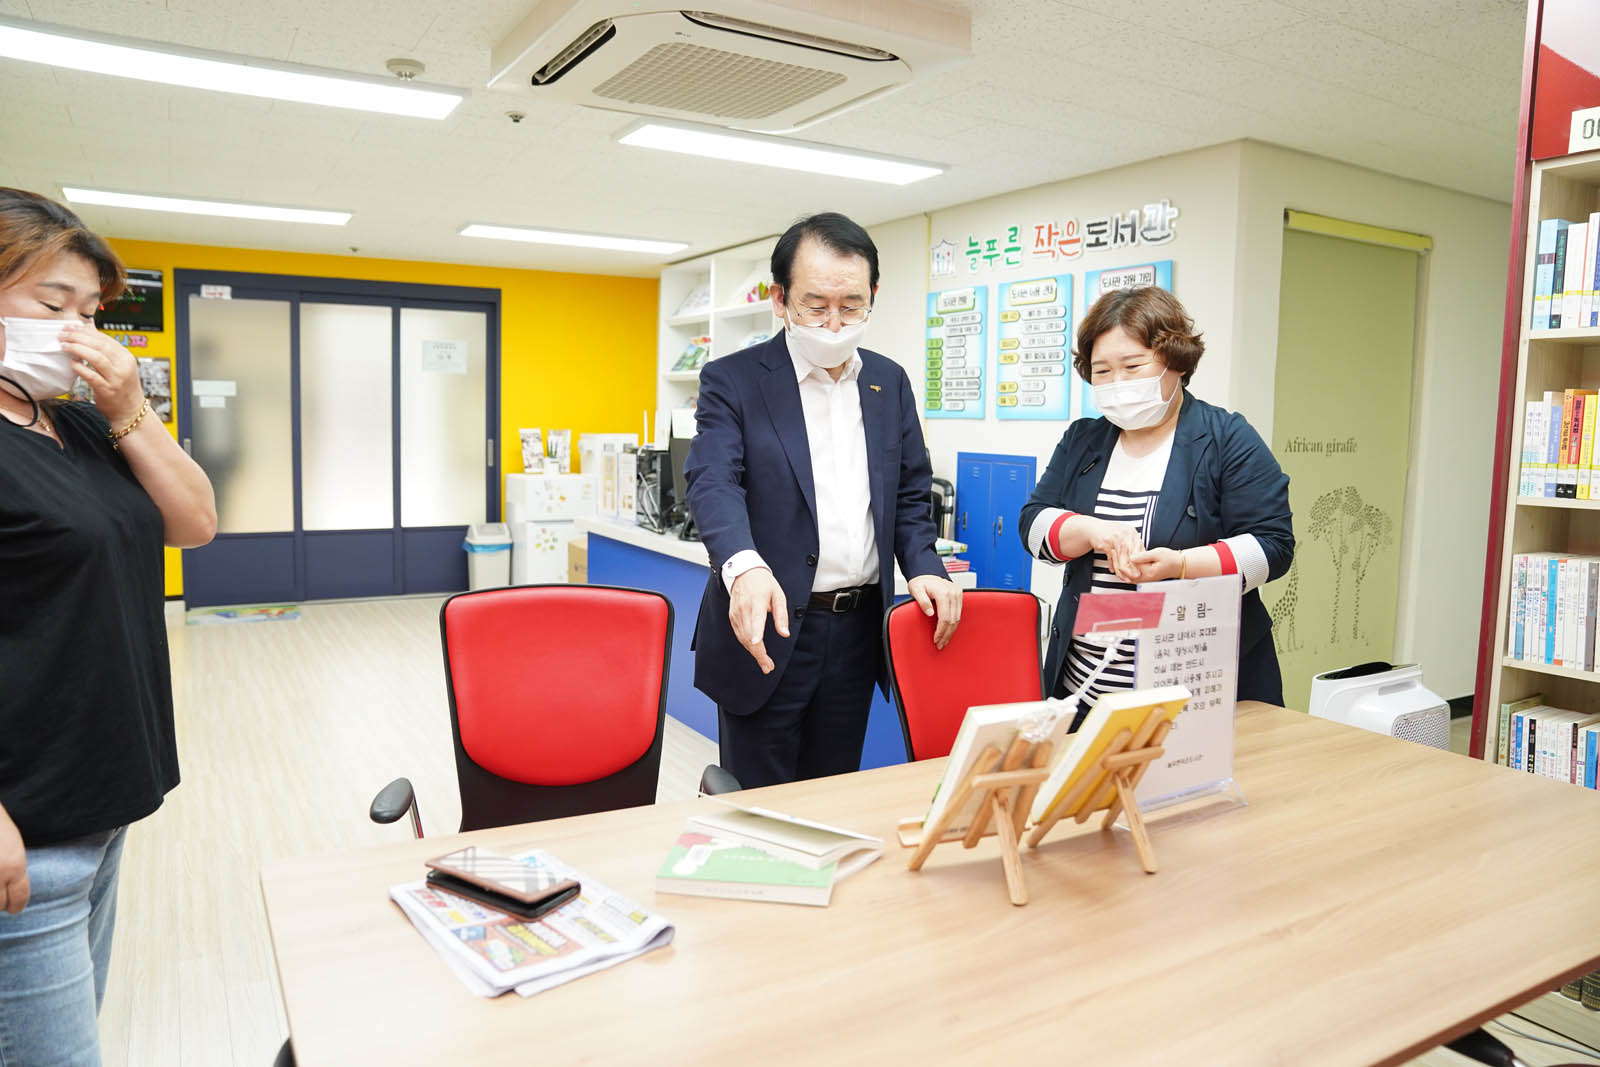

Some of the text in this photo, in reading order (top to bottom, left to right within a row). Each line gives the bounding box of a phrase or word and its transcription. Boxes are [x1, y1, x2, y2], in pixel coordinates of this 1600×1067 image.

[966, 225, 1022, 270] 늘푸른
[1284, 436, 1358, 457] African giraffe
